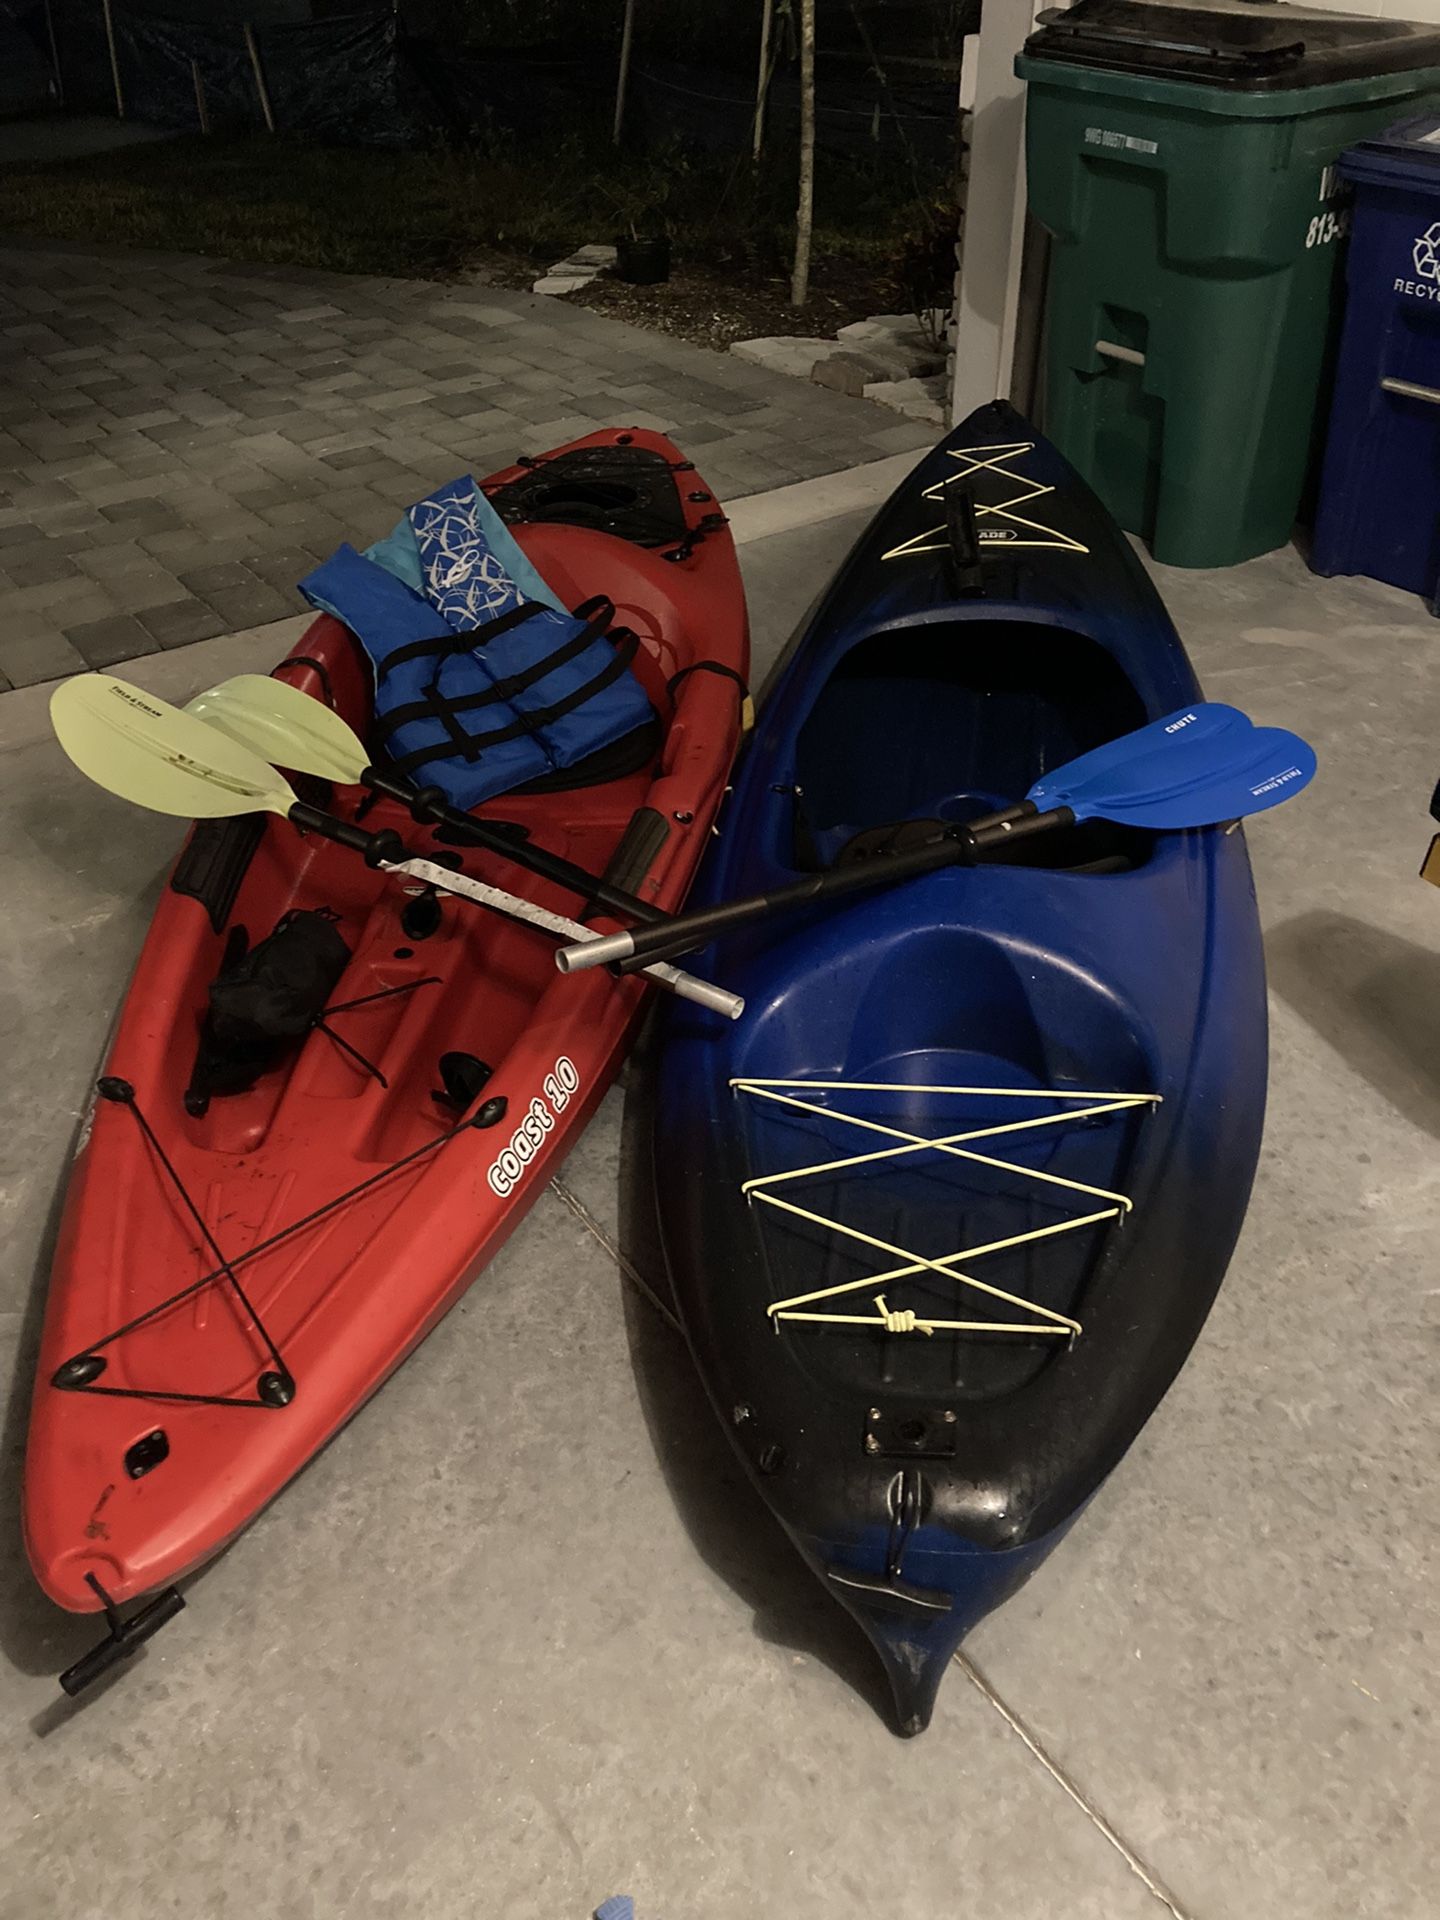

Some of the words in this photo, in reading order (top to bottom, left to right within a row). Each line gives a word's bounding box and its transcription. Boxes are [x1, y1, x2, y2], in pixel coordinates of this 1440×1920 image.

[978, 531, 1008, 539] ADE
[1164, 713, 1198, 734] CHUTE
[543, 1055, 580, 1114] 10
